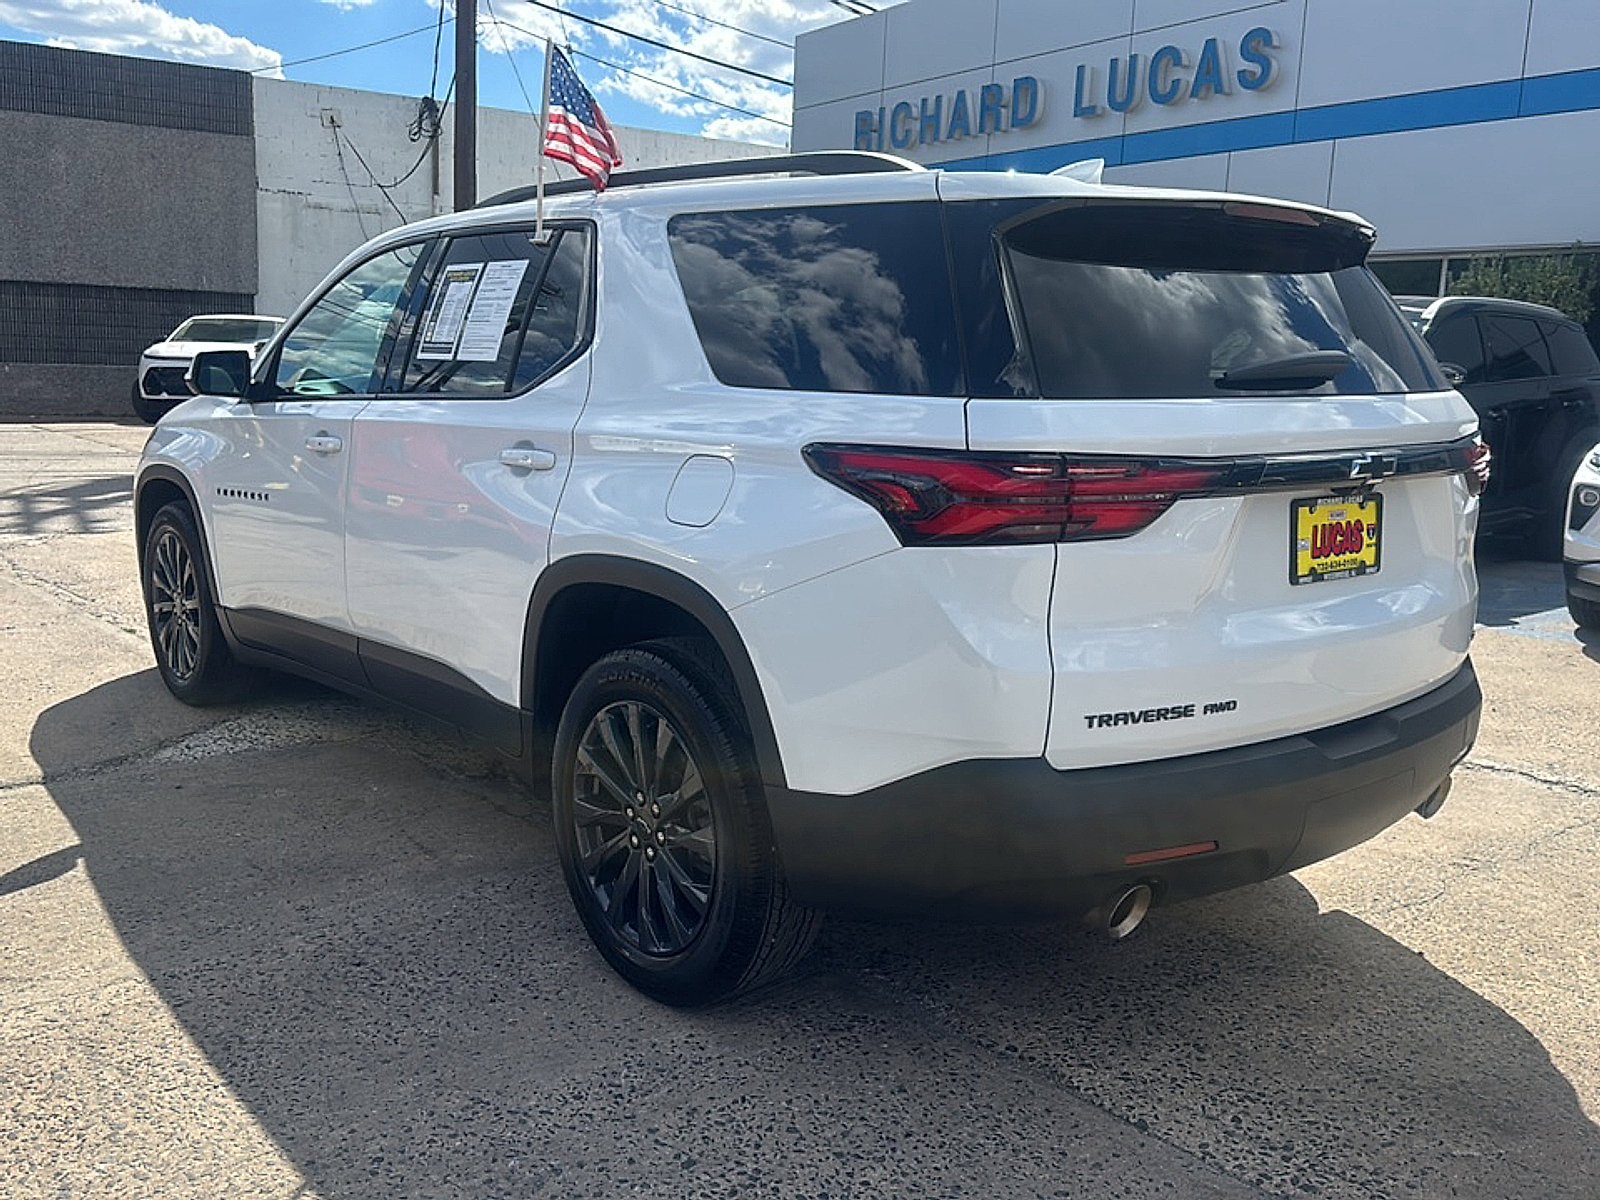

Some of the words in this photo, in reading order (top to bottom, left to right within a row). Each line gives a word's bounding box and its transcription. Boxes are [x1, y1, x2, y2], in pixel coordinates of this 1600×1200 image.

[853, 76, 1045, 151] RICHARD
[1073, 26, 1280, 118] LUCAS
[1312, 519, 1364, 559] LUCAS
[1084, 704, 1196, 729] TRAVERSE
[1203, 700, 1238, 716] AWD
